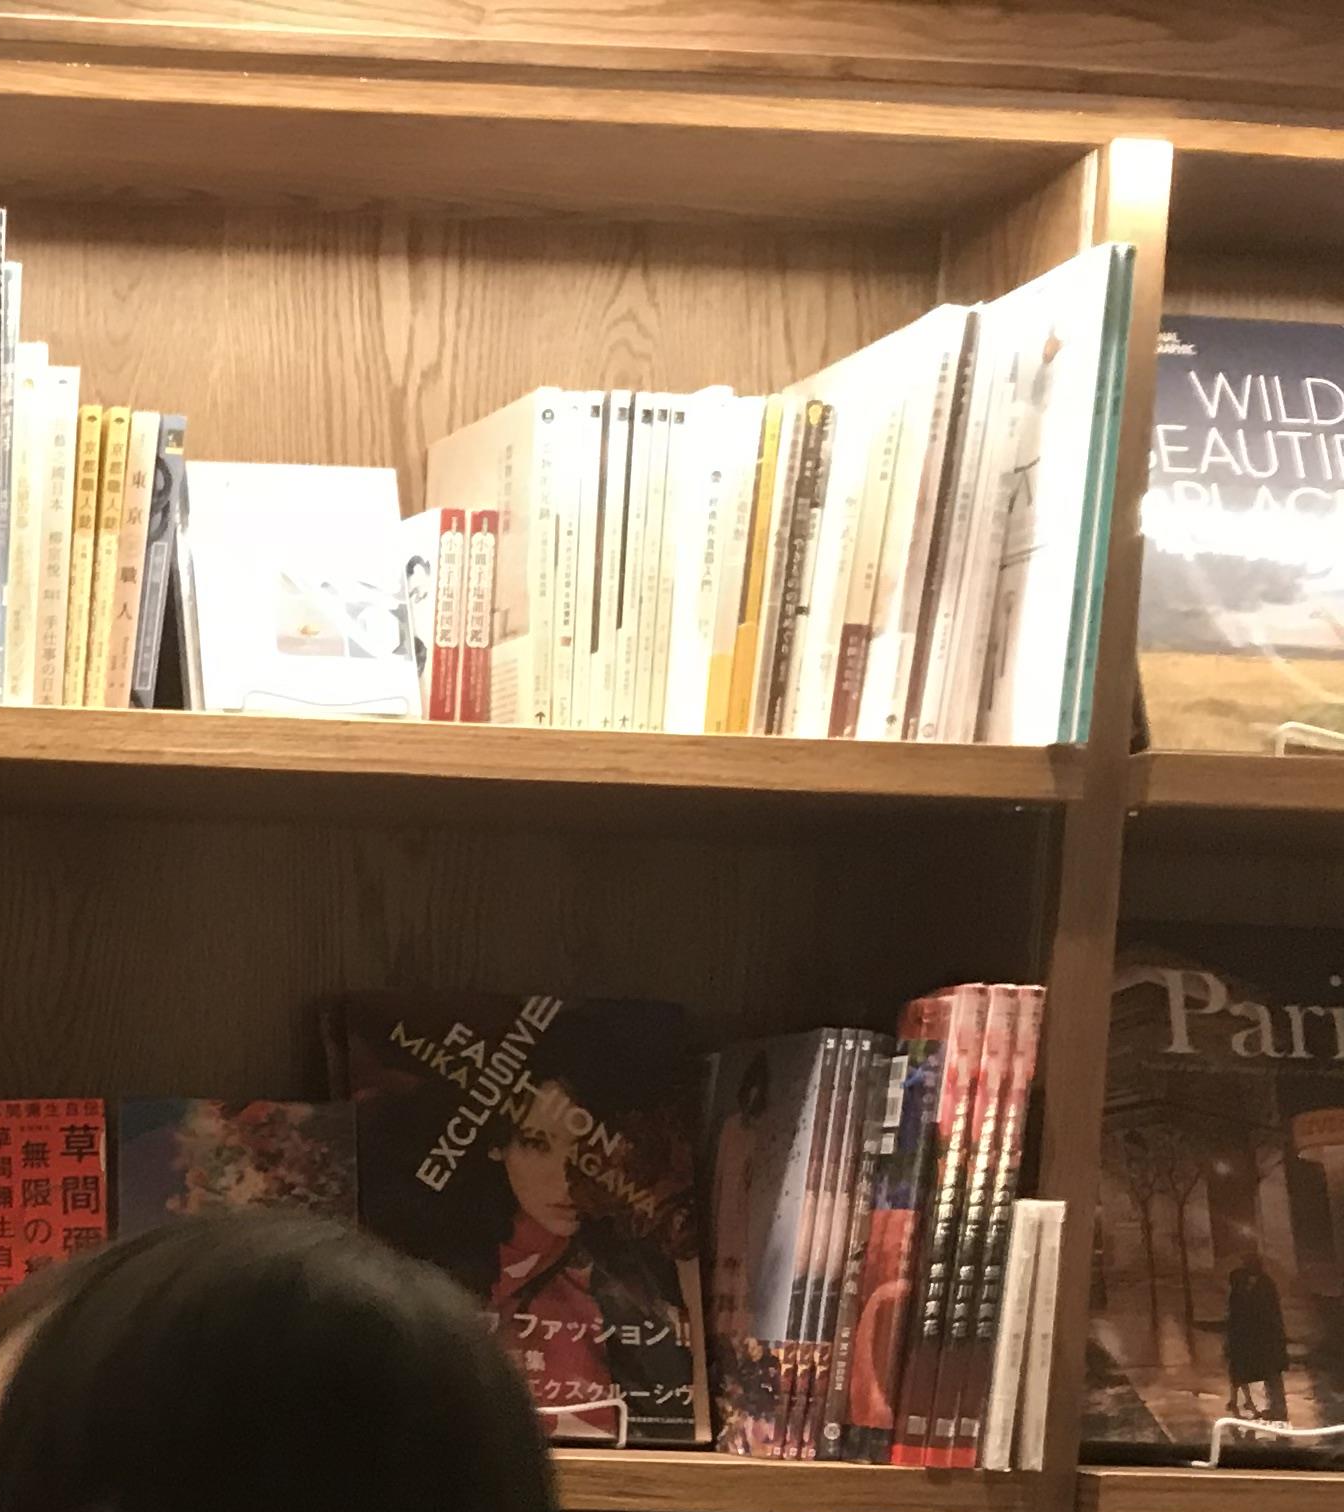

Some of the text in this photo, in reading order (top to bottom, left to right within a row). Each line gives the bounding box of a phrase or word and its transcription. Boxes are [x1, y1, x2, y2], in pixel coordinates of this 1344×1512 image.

[1188, 370, 1344, 426] WILD
[1163, 969, 1344, 1060] Pari
[389, 1021, 469, 1089] MIKA
[416, 994, 563, 1192] EXCLUSIVE
